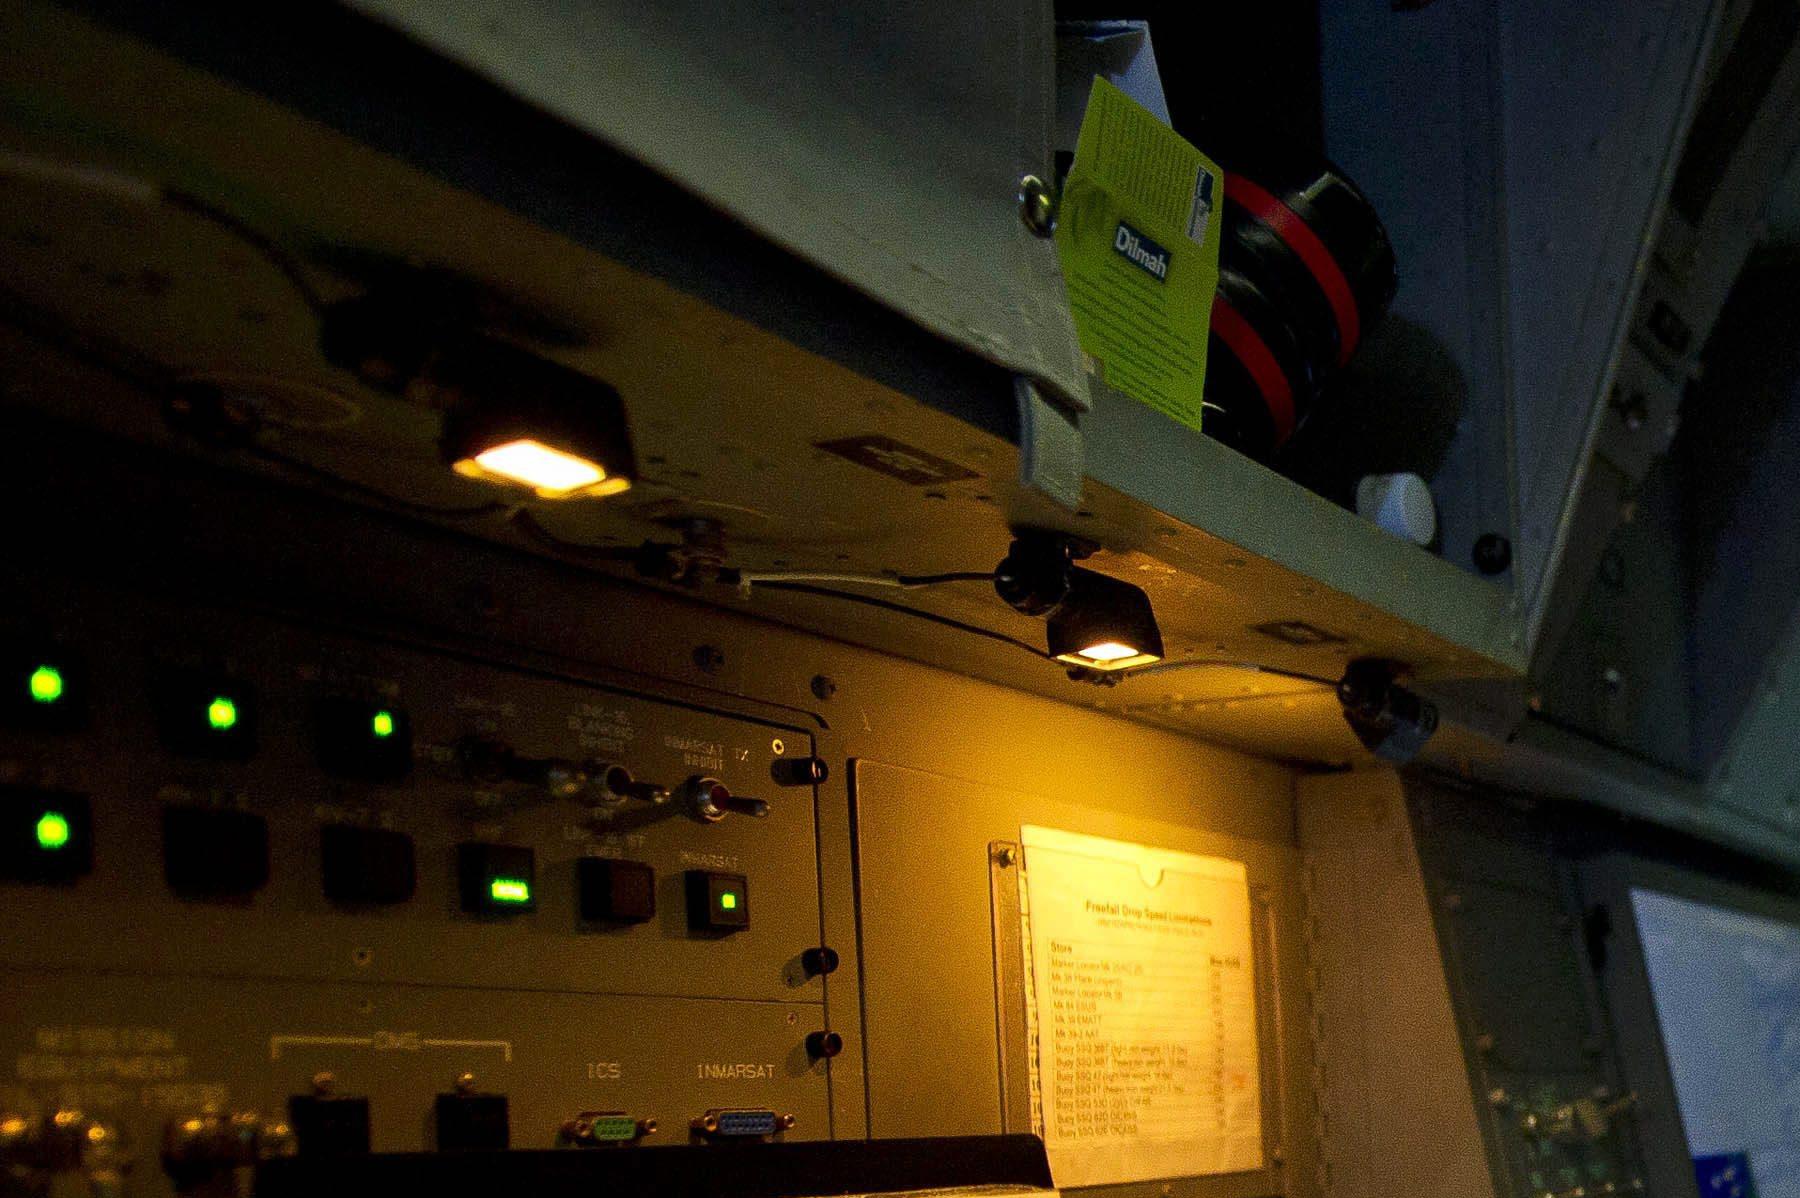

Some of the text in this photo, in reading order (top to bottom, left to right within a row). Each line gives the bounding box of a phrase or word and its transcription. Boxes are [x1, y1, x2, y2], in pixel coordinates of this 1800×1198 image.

[1115, 226, 1167, 280] Dilmah
[588, 1062, 621, 1079] ICS
[697, 1063, 775, 1079] INMARSAT
